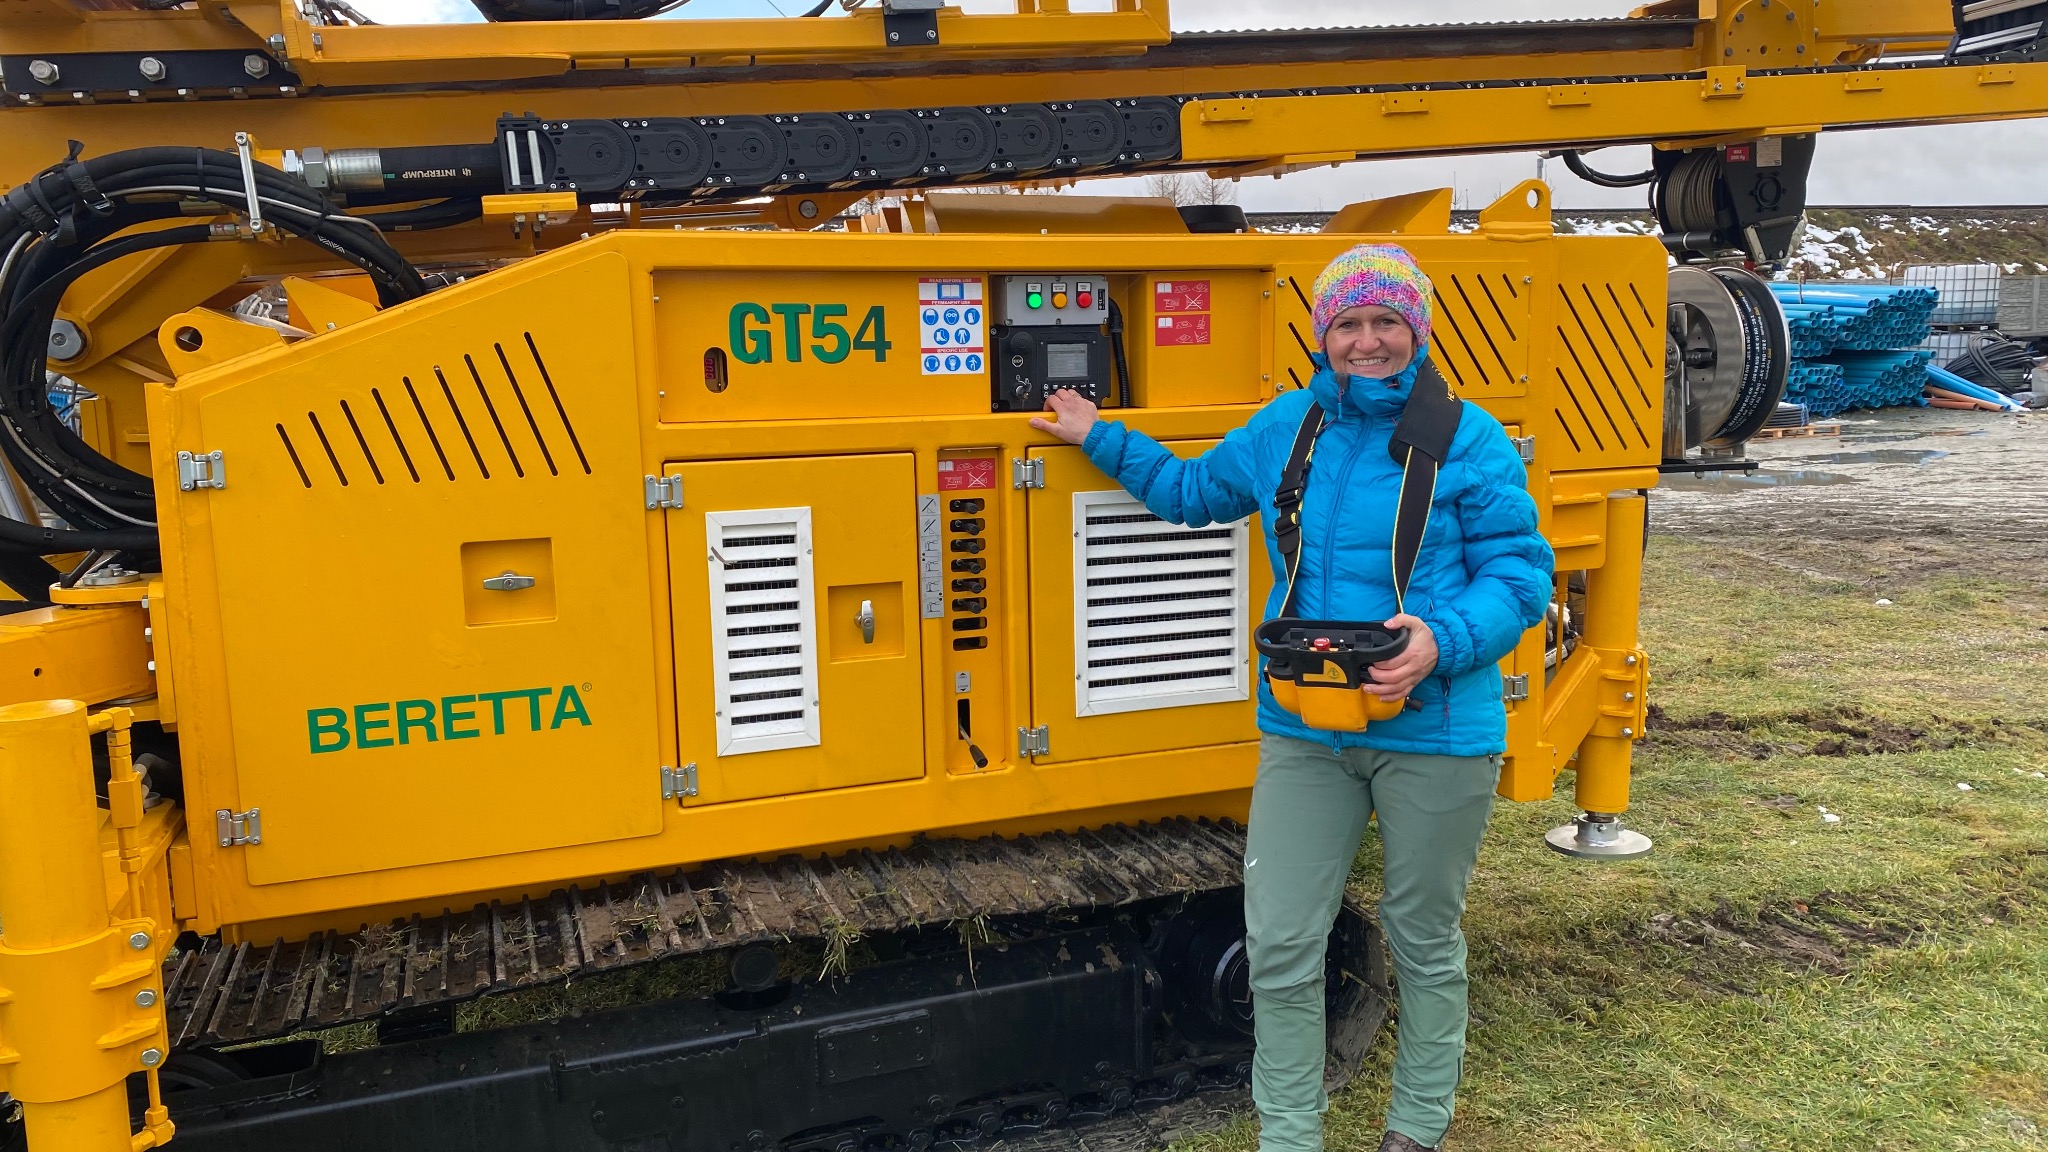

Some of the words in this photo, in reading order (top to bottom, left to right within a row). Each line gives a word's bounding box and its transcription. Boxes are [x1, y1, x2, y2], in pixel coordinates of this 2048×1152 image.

[402, 169, 456, 178] INTERPUMP
[728, 302, 892, 364] GT54
[306, 684, 592, 754] BERETTA
